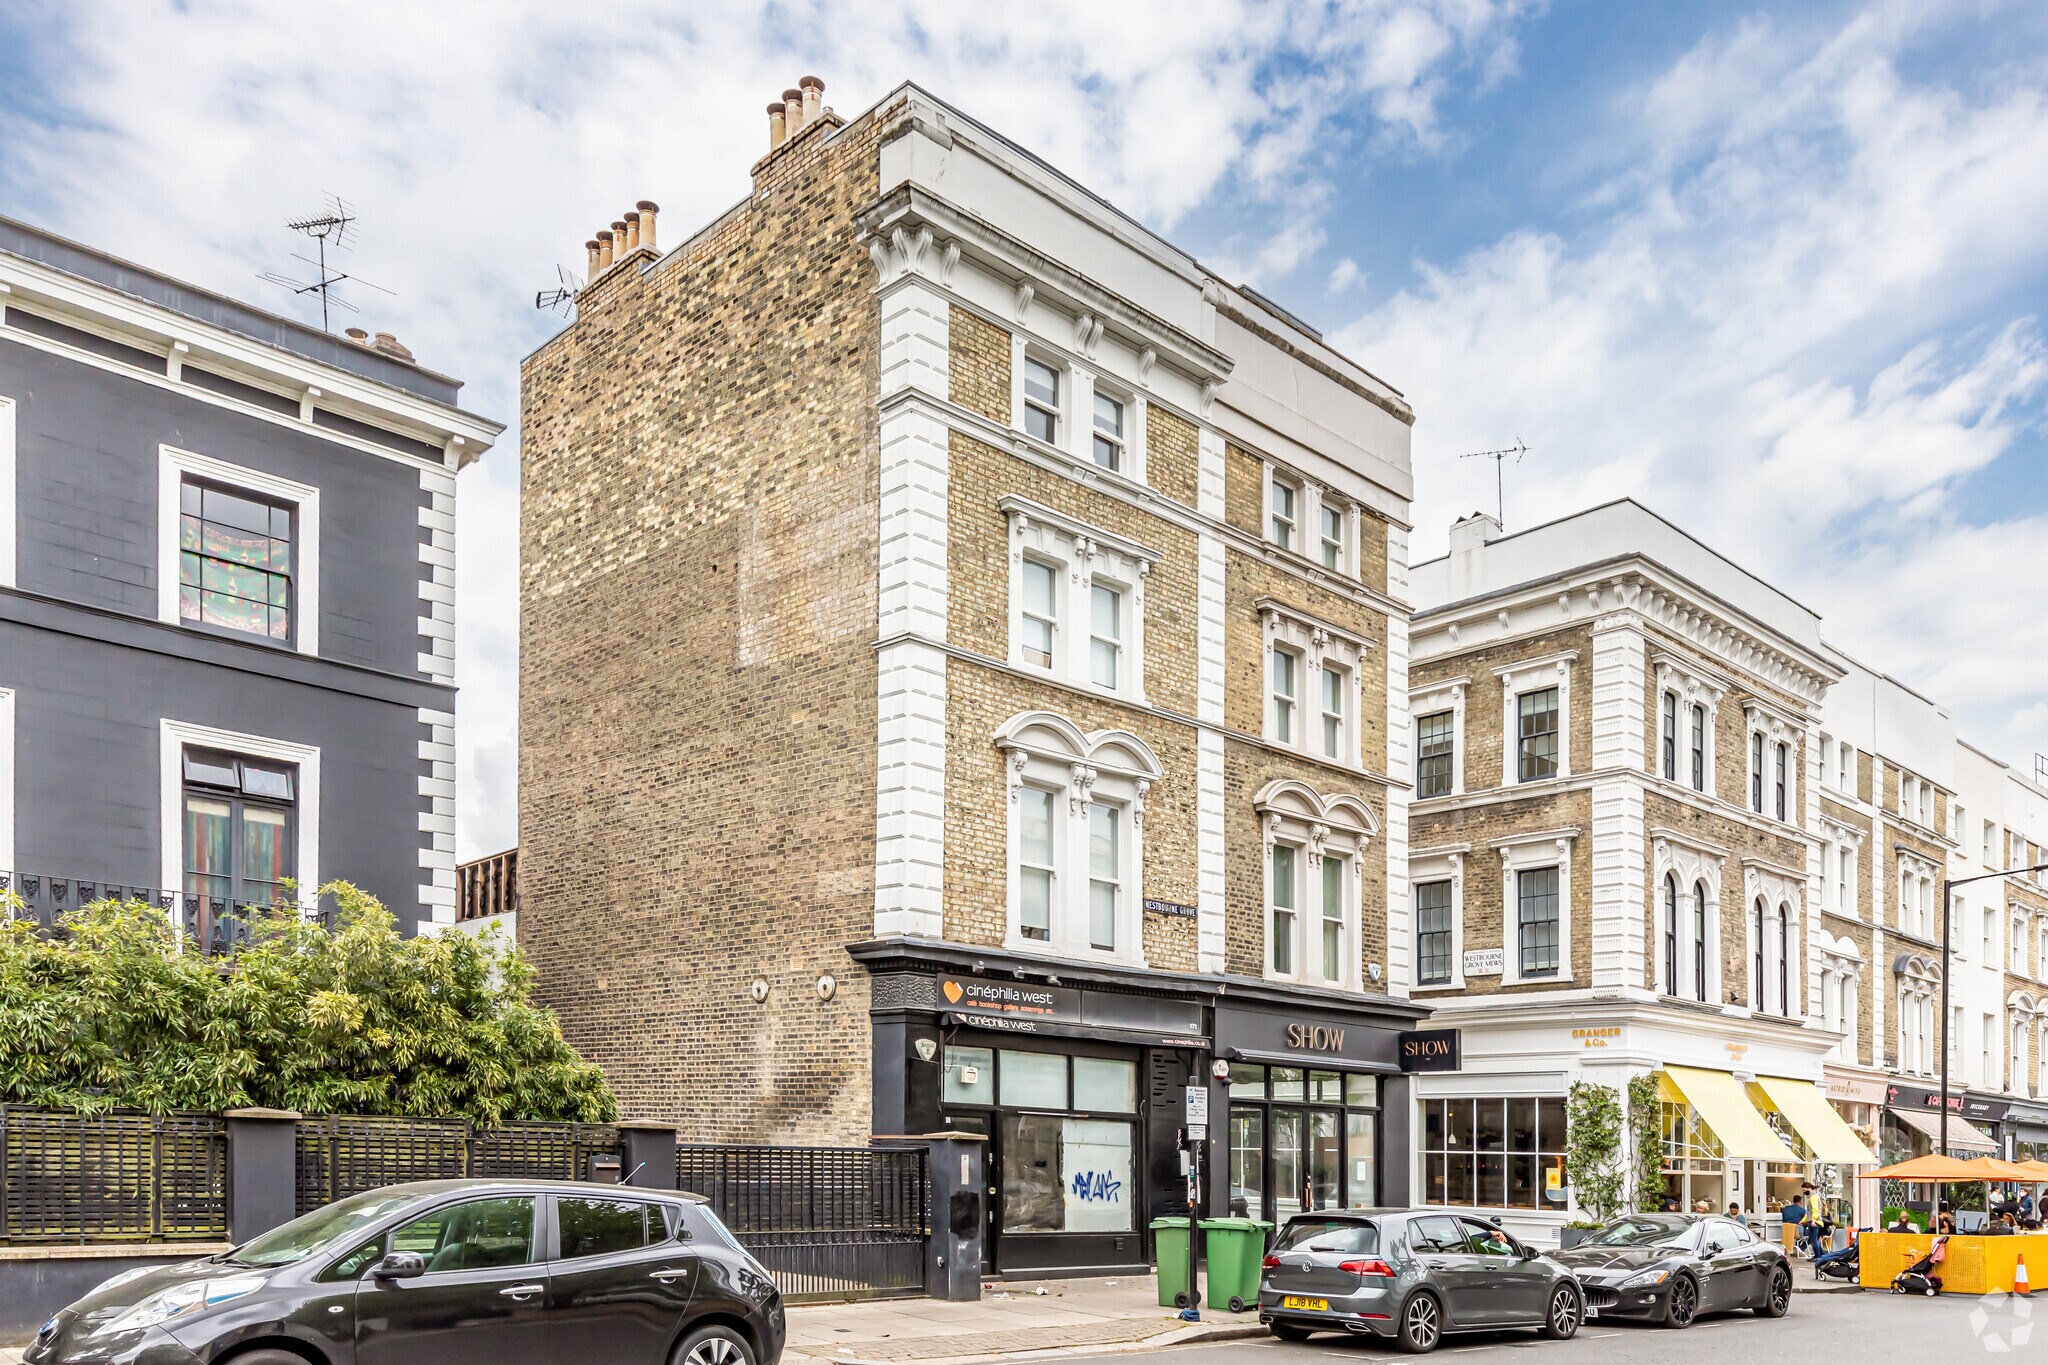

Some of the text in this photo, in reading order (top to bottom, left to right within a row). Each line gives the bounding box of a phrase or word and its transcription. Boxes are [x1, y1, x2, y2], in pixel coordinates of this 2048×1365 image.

[1145, 901, 1196, 917] WESTBOURNE GROVE
[1465, 953, 1502, 962] WESTBOURNE
[1465, 961, 1484, 969] GROVE
[966, 984, 1053, 1005] cinéphilia west
[978, 1001, 1002, 1009] bookshop
[1003, 1004, 1019, 1012] gallery
[968, 1015, 1037, 1032] cinéphilia west
[1286, 1023, 1345, 1052] SHOW
[1571, 1027, 1621, 1038] GRANGER
[1404, 1040, 1451, 1057] SHOW
[1584, 1038, 1608, 1047] & Co.
[1289, 1297, 1323, 1309] LJ18 VHL
